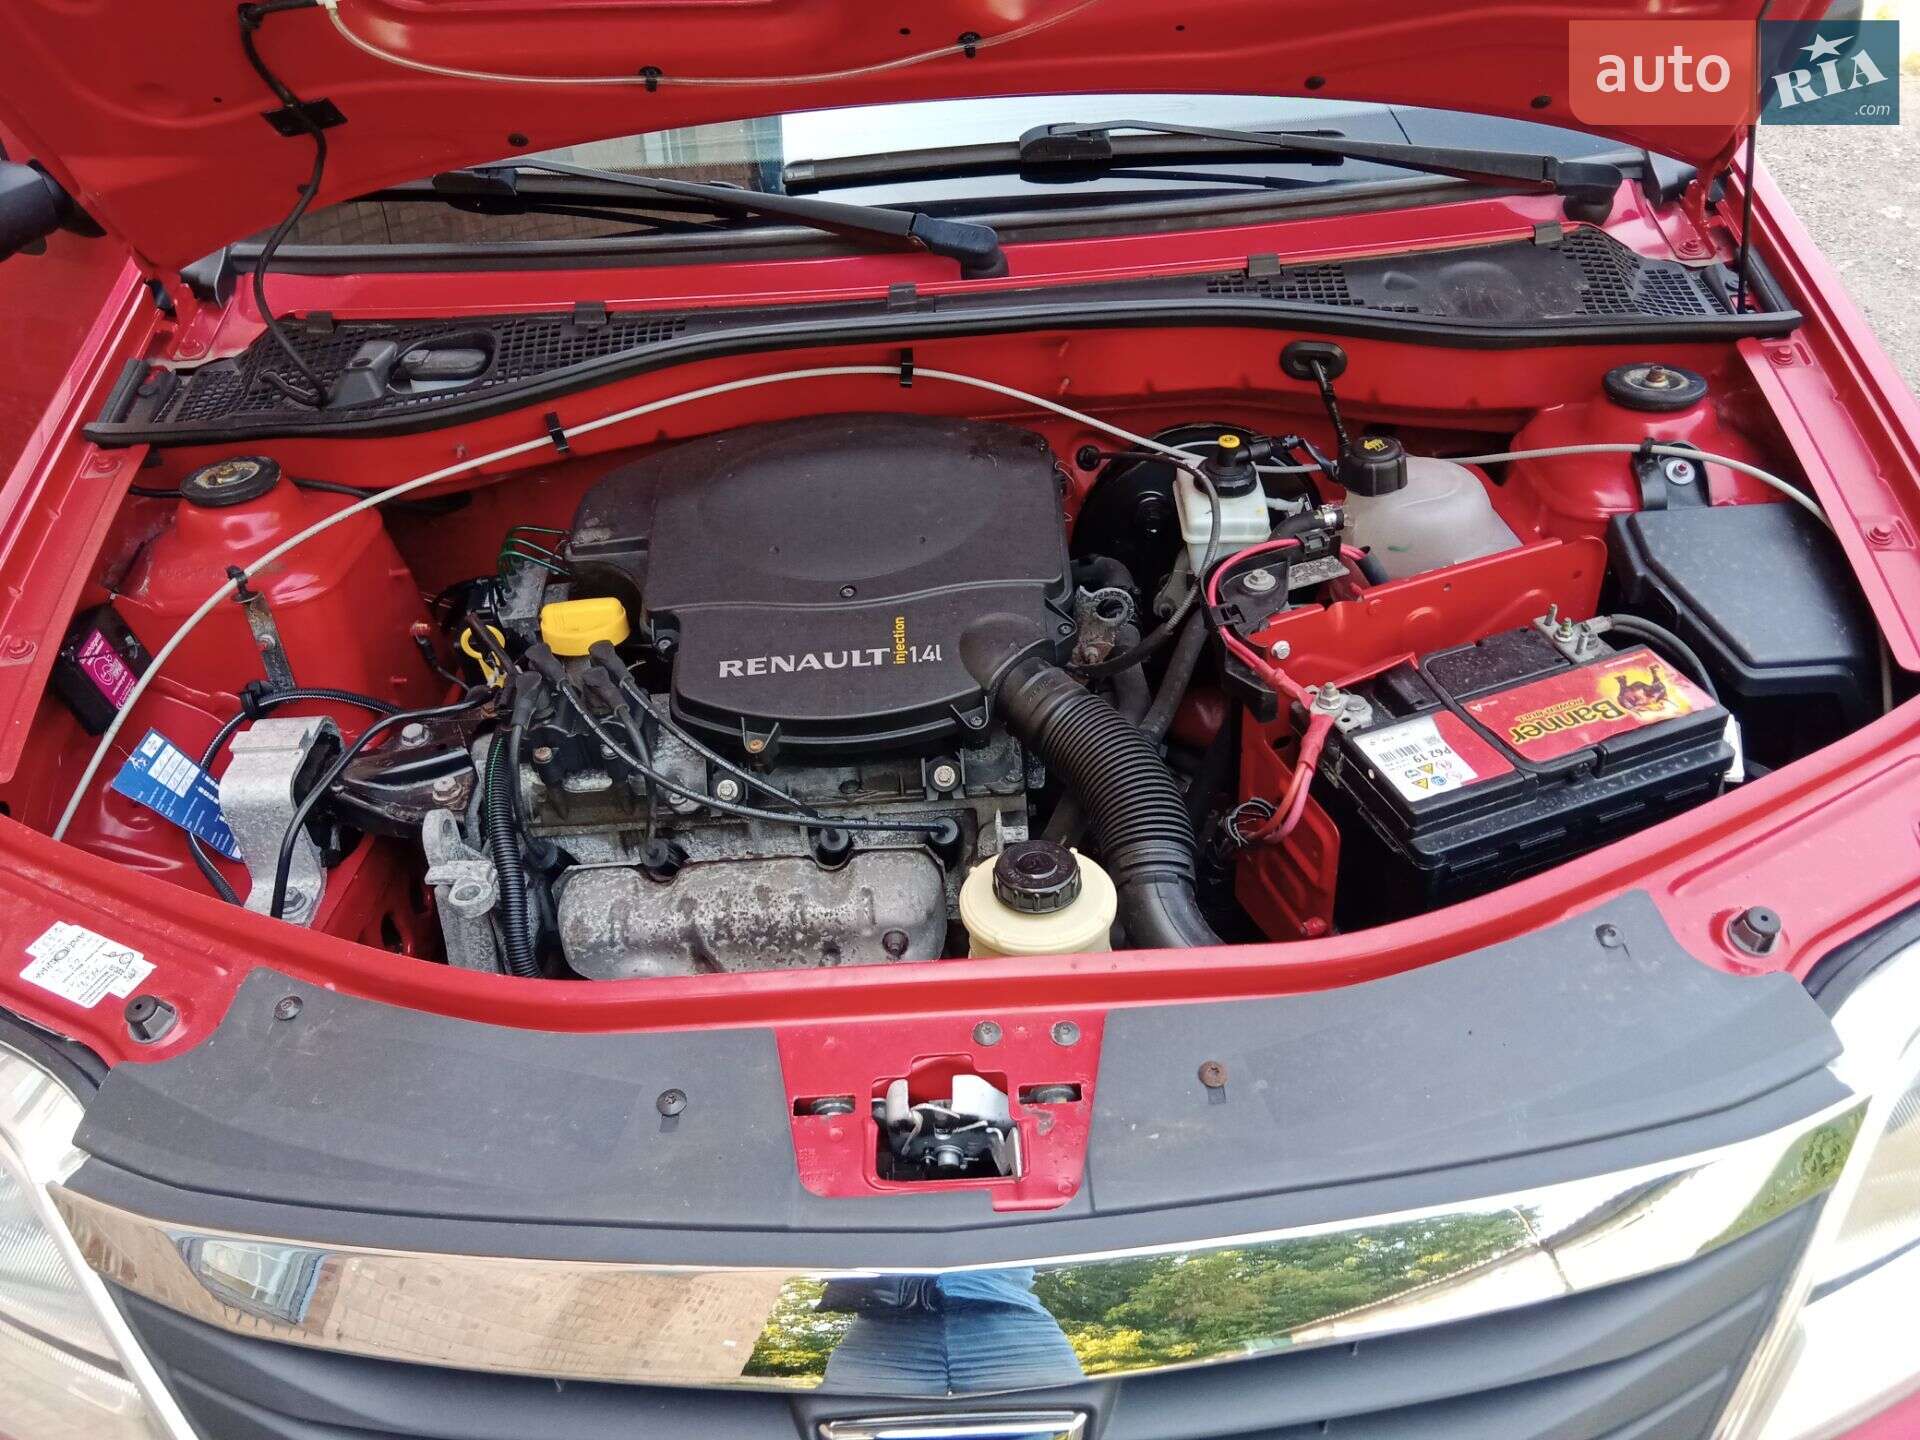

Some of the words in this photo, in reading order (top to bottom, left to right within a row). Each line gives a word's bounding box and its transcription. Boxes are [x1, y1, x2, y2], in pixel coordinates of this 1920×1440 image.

[893, 616, 910, 665] injection
[718, 648, 891, 678] RENAULT
[1509, 699, 1627, 743] Banner
